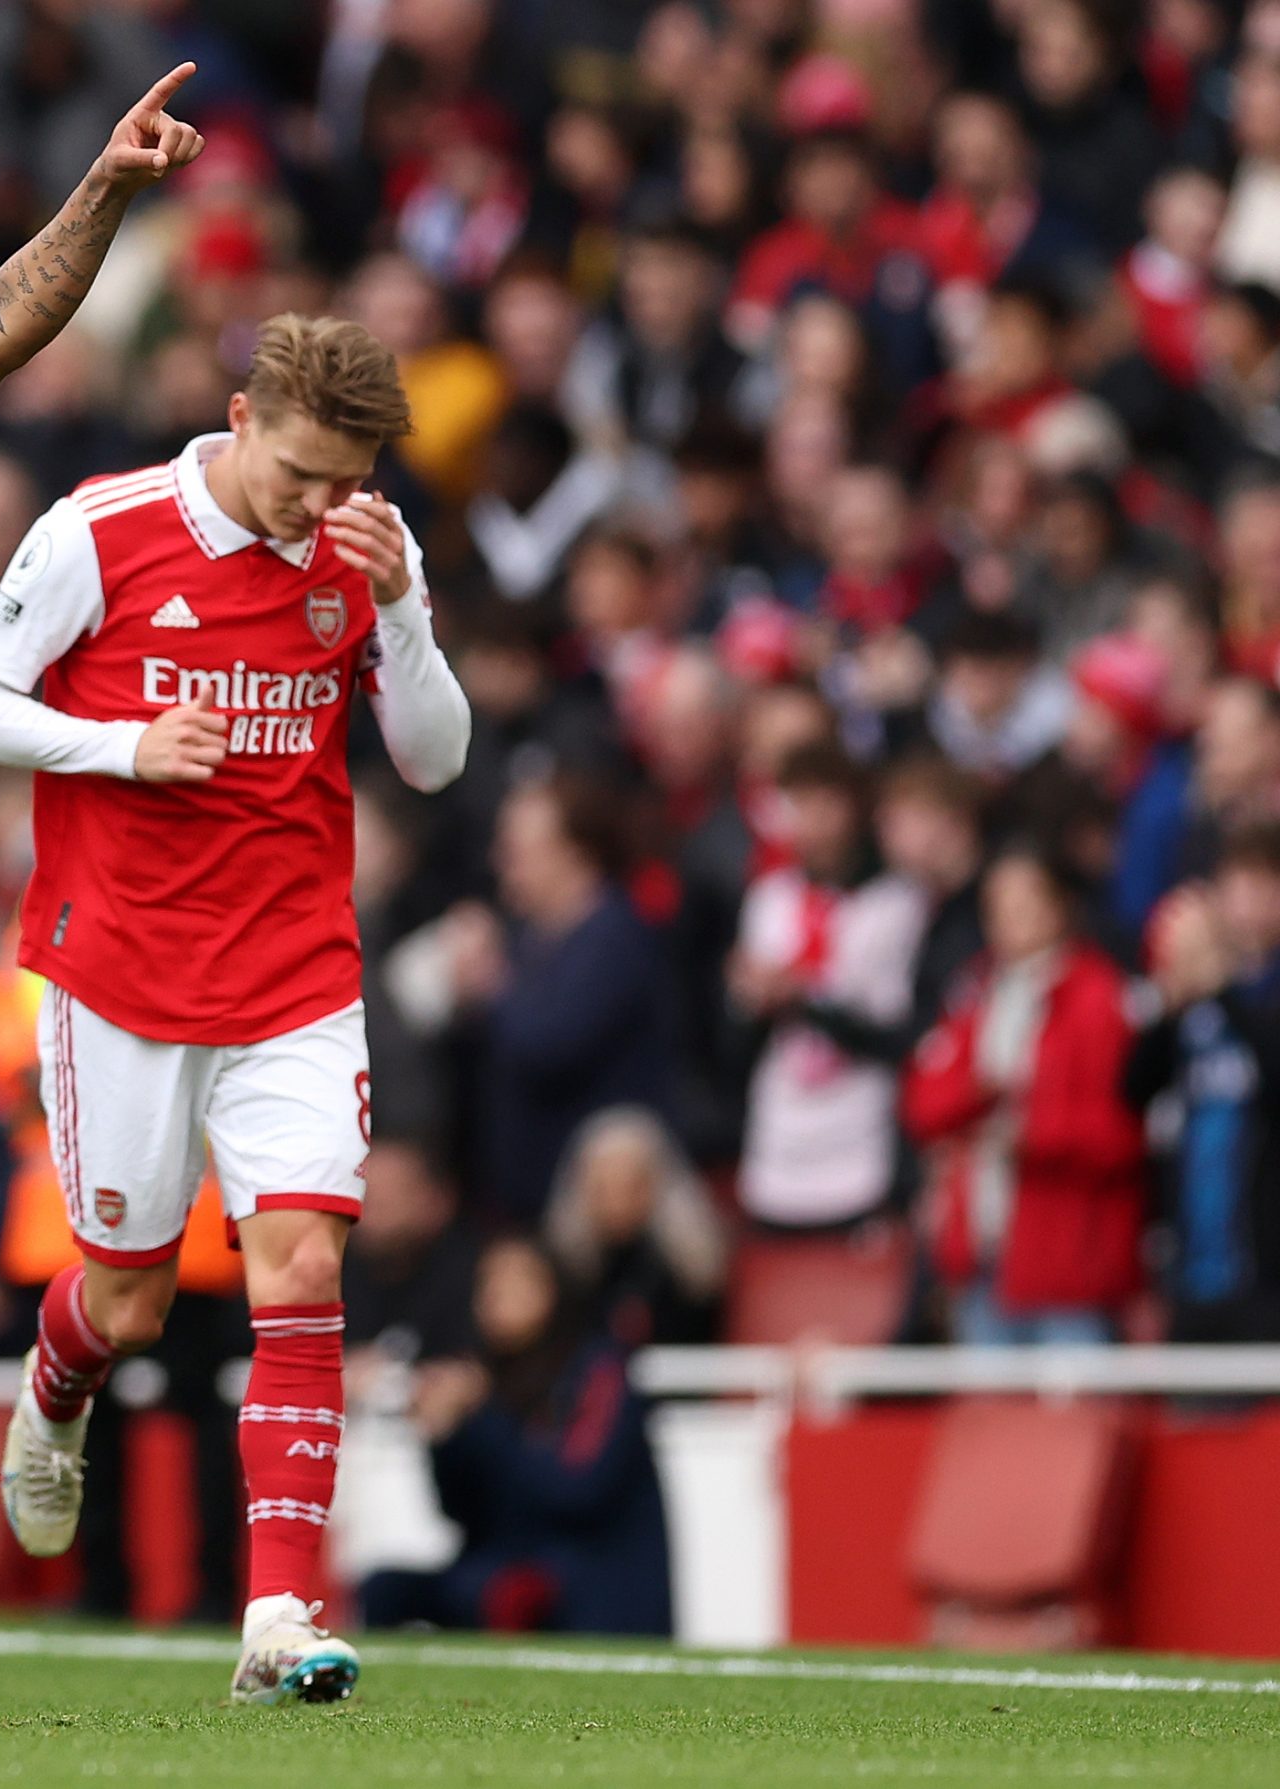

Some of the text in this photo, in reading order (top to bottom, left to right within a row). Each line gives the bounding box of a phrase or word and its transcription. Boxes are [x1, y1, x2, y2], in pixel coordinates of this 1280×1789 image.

[142, 656, 341, 711] Emirates
[229, 714, 315, 755] BETTER
[285, 1439, 339, 1462] AF
